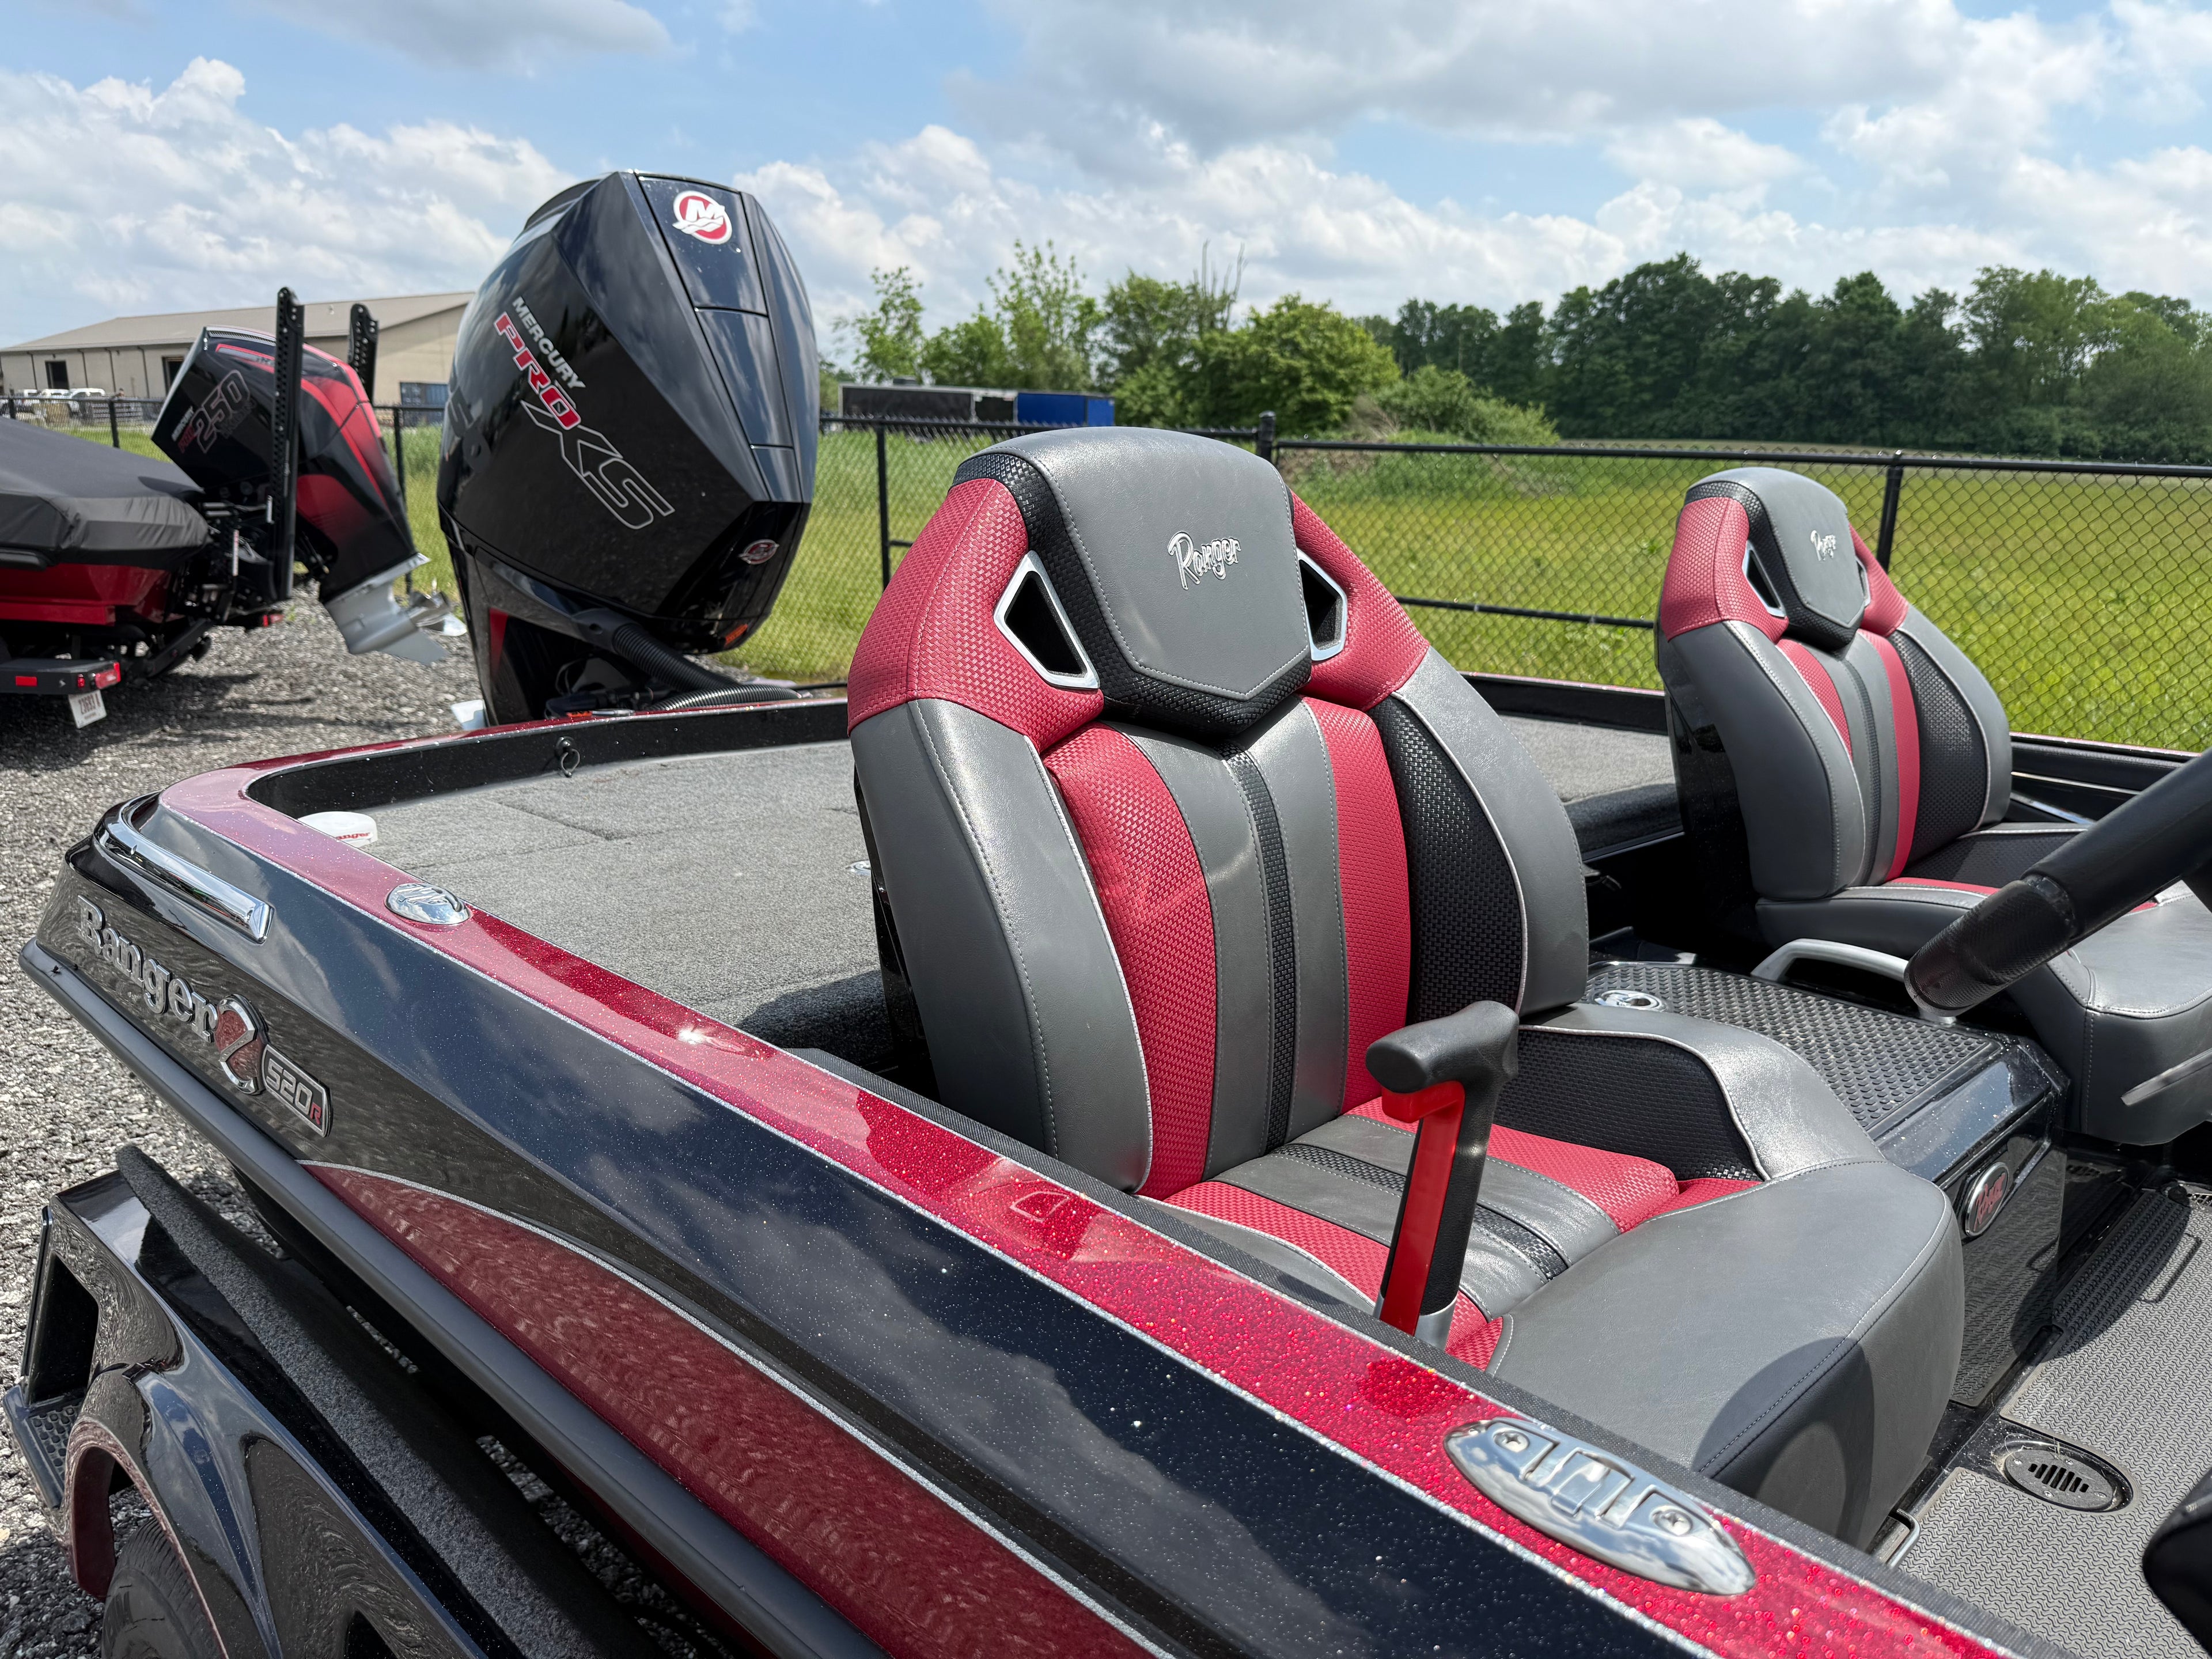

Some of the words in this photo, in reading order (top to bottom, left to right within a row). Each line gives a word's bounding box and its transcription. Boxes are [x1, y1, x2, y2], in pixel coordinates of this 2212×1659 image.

[493, 311, 581, 430] PRO
[512, 296, 586, 388] MERCURY
[190, 369, 251, 453] 250
[520, 379, 676, 529] XS
[1167, 531, 1241, 590] Ranger
[335, 832, 370, 840] anger
[77, 895, 218, 1043] Ranger
[266, 1058, 323, 1126] 520R
